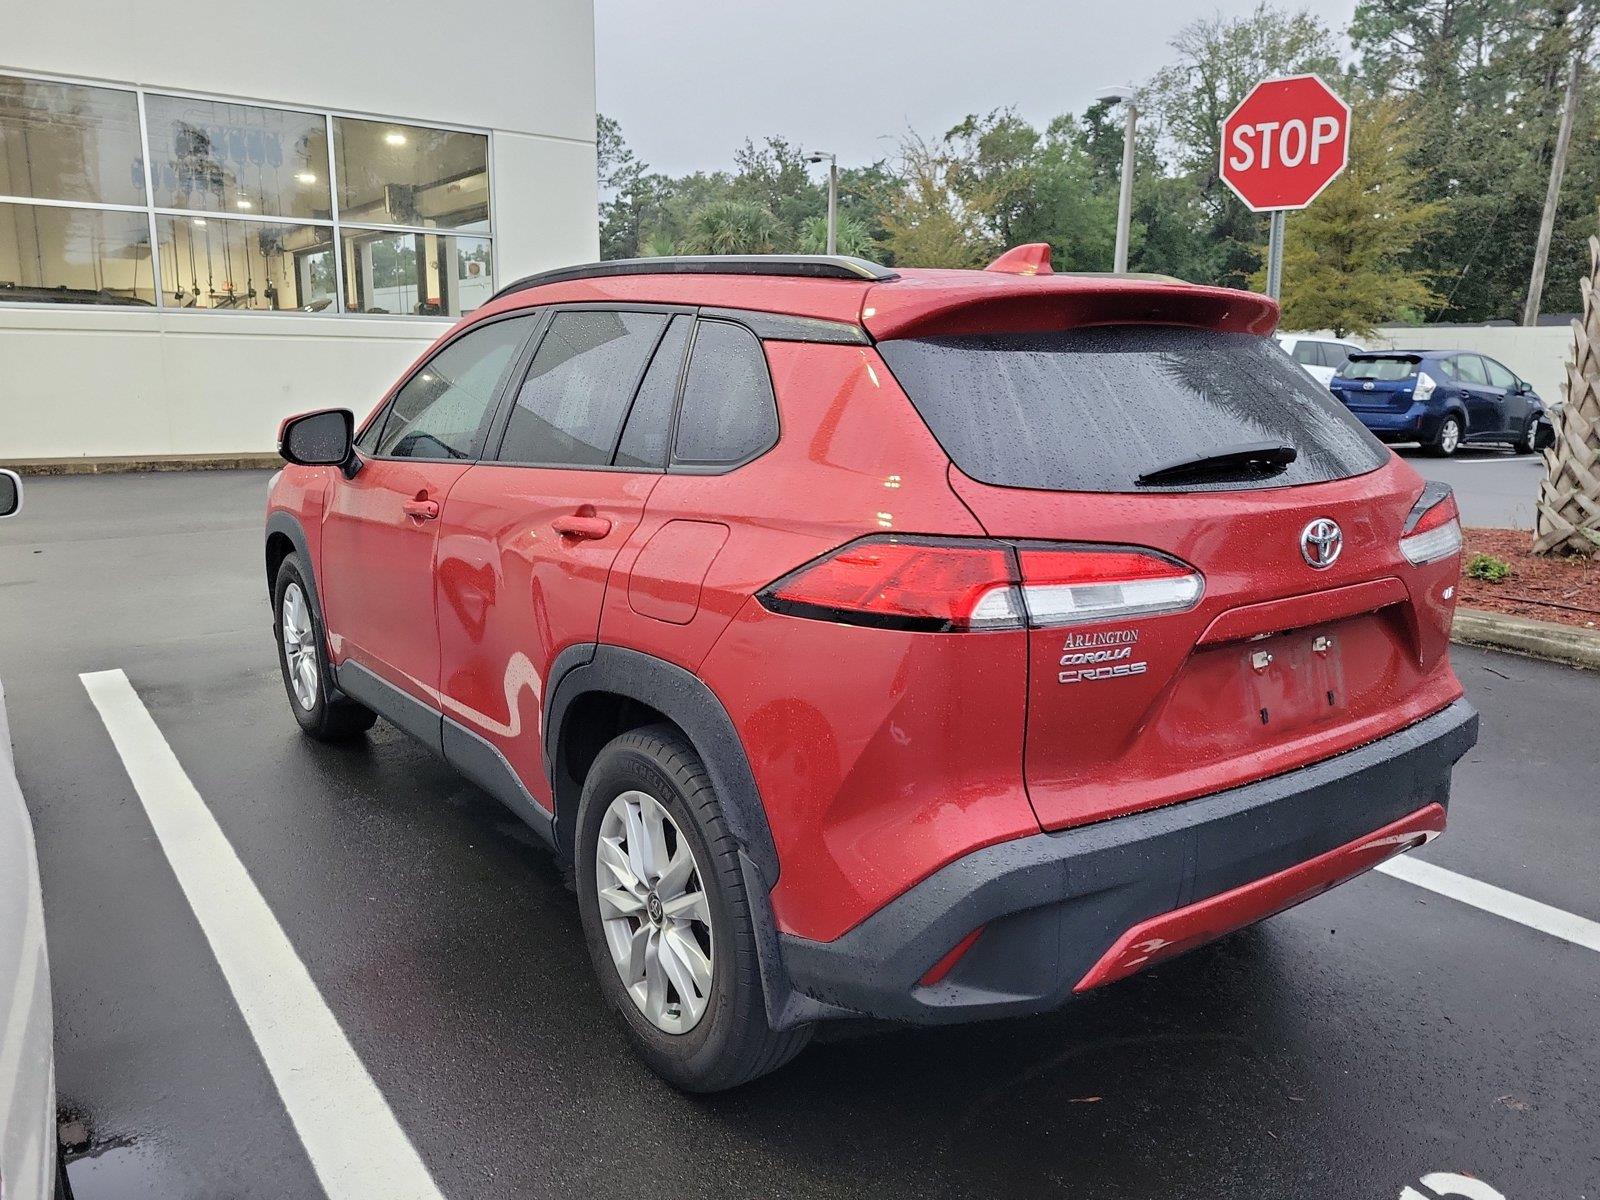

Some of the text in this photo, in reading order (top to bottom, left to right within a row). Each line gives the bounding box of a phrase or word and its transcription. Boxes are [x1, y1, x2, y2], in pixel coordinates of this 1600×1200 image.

[1229, 115, 1340, 172] STOP
[1063, 629, 1139, 649] ARLINGTON
[1060, 647, 1132, 666] COROLLA
[1058, 662, 1148, 683] CROSS
